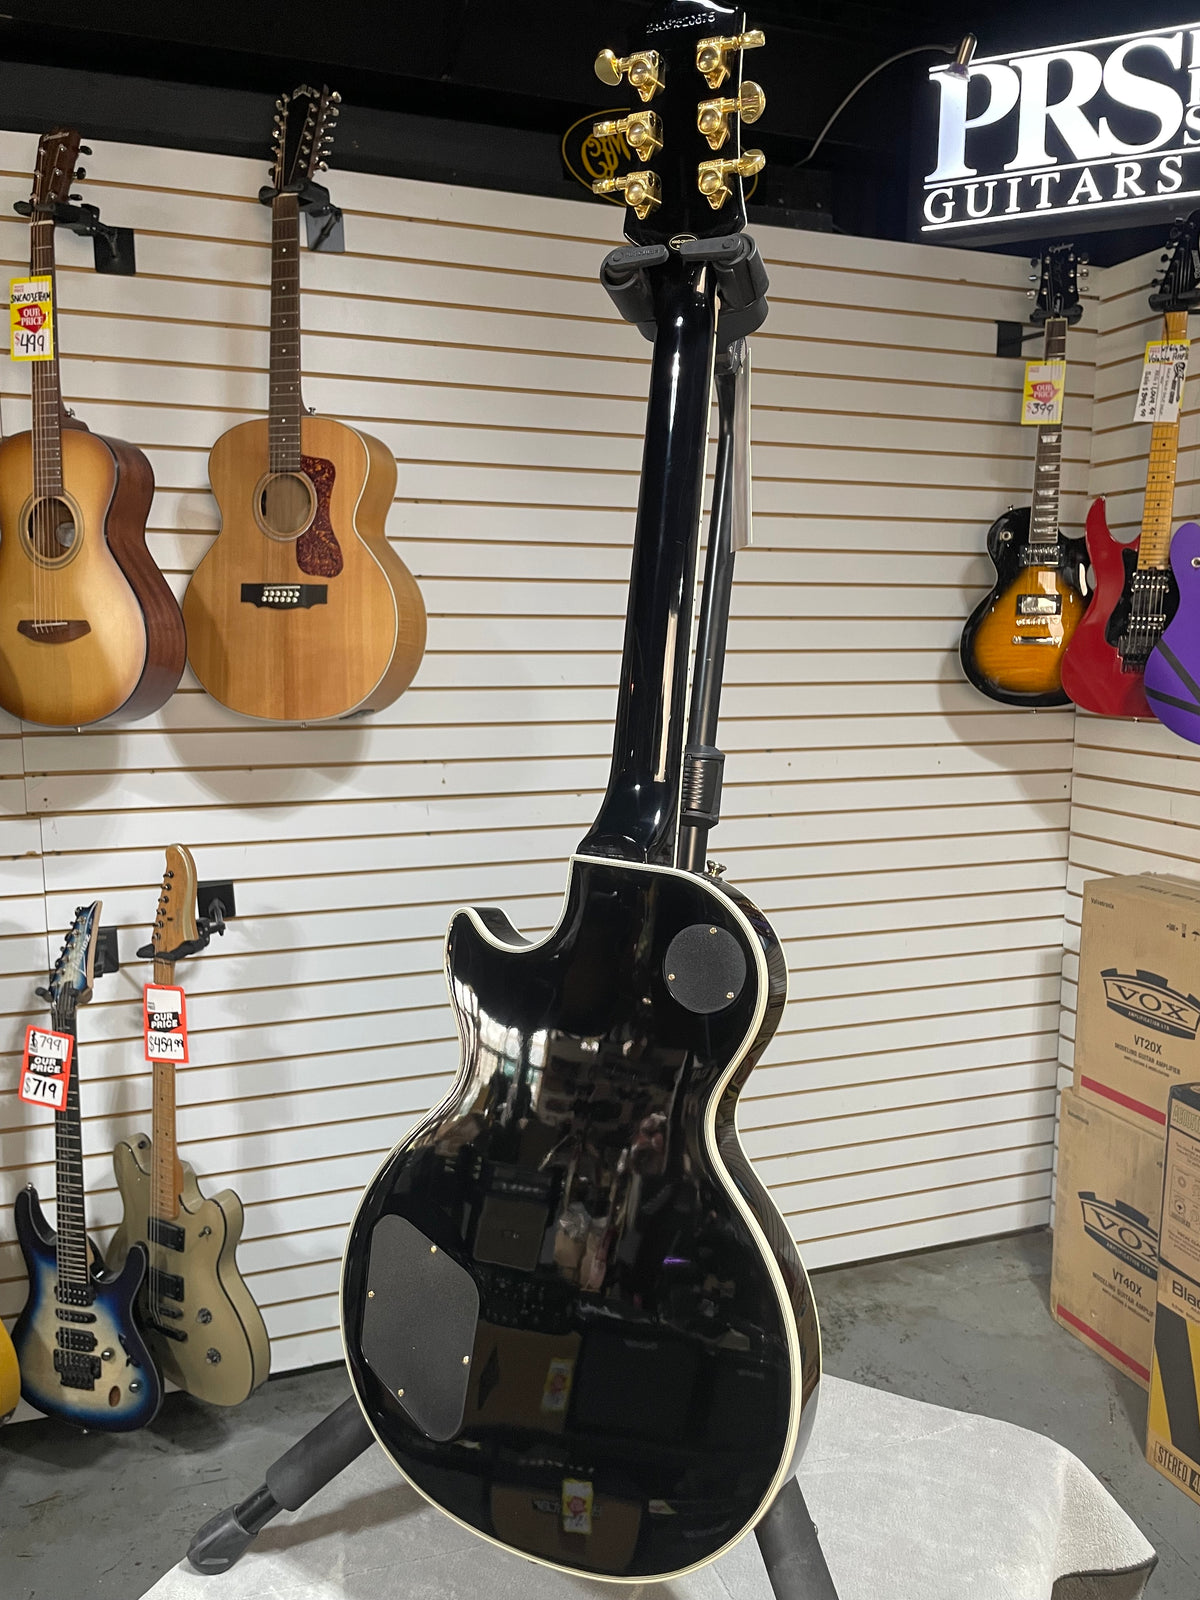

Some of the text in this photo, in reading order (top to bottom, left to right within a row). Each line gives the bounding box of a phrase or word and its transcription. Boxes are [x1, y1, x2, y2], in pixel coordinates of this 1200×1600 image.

[924, 30, 1184, 183] PRS
[923, 155, 1183, 224] GUITARS
[20, 316, 44, 326] PRICE
[23, 308, 41, 317] OUR
[14, 332, 45, 354] $499
[1026, 402, 1054, 415] $399
[1112, 982, 1189, 1024] VOX
[150, 1019, 178, 1029] PRICE
[153, 1012, 173, 1021] OUR
[1134, 1034, 1162, 1056] VT20X
[30, 1062, 62, 1074] PRICE
[34, 1056, 57, 1066] OUR
[24, 1077, 57, 1100] $719
[1112, 1268, 1143, 1298] VT40X
[1158, 1446, 1188, 1482] STEREO
